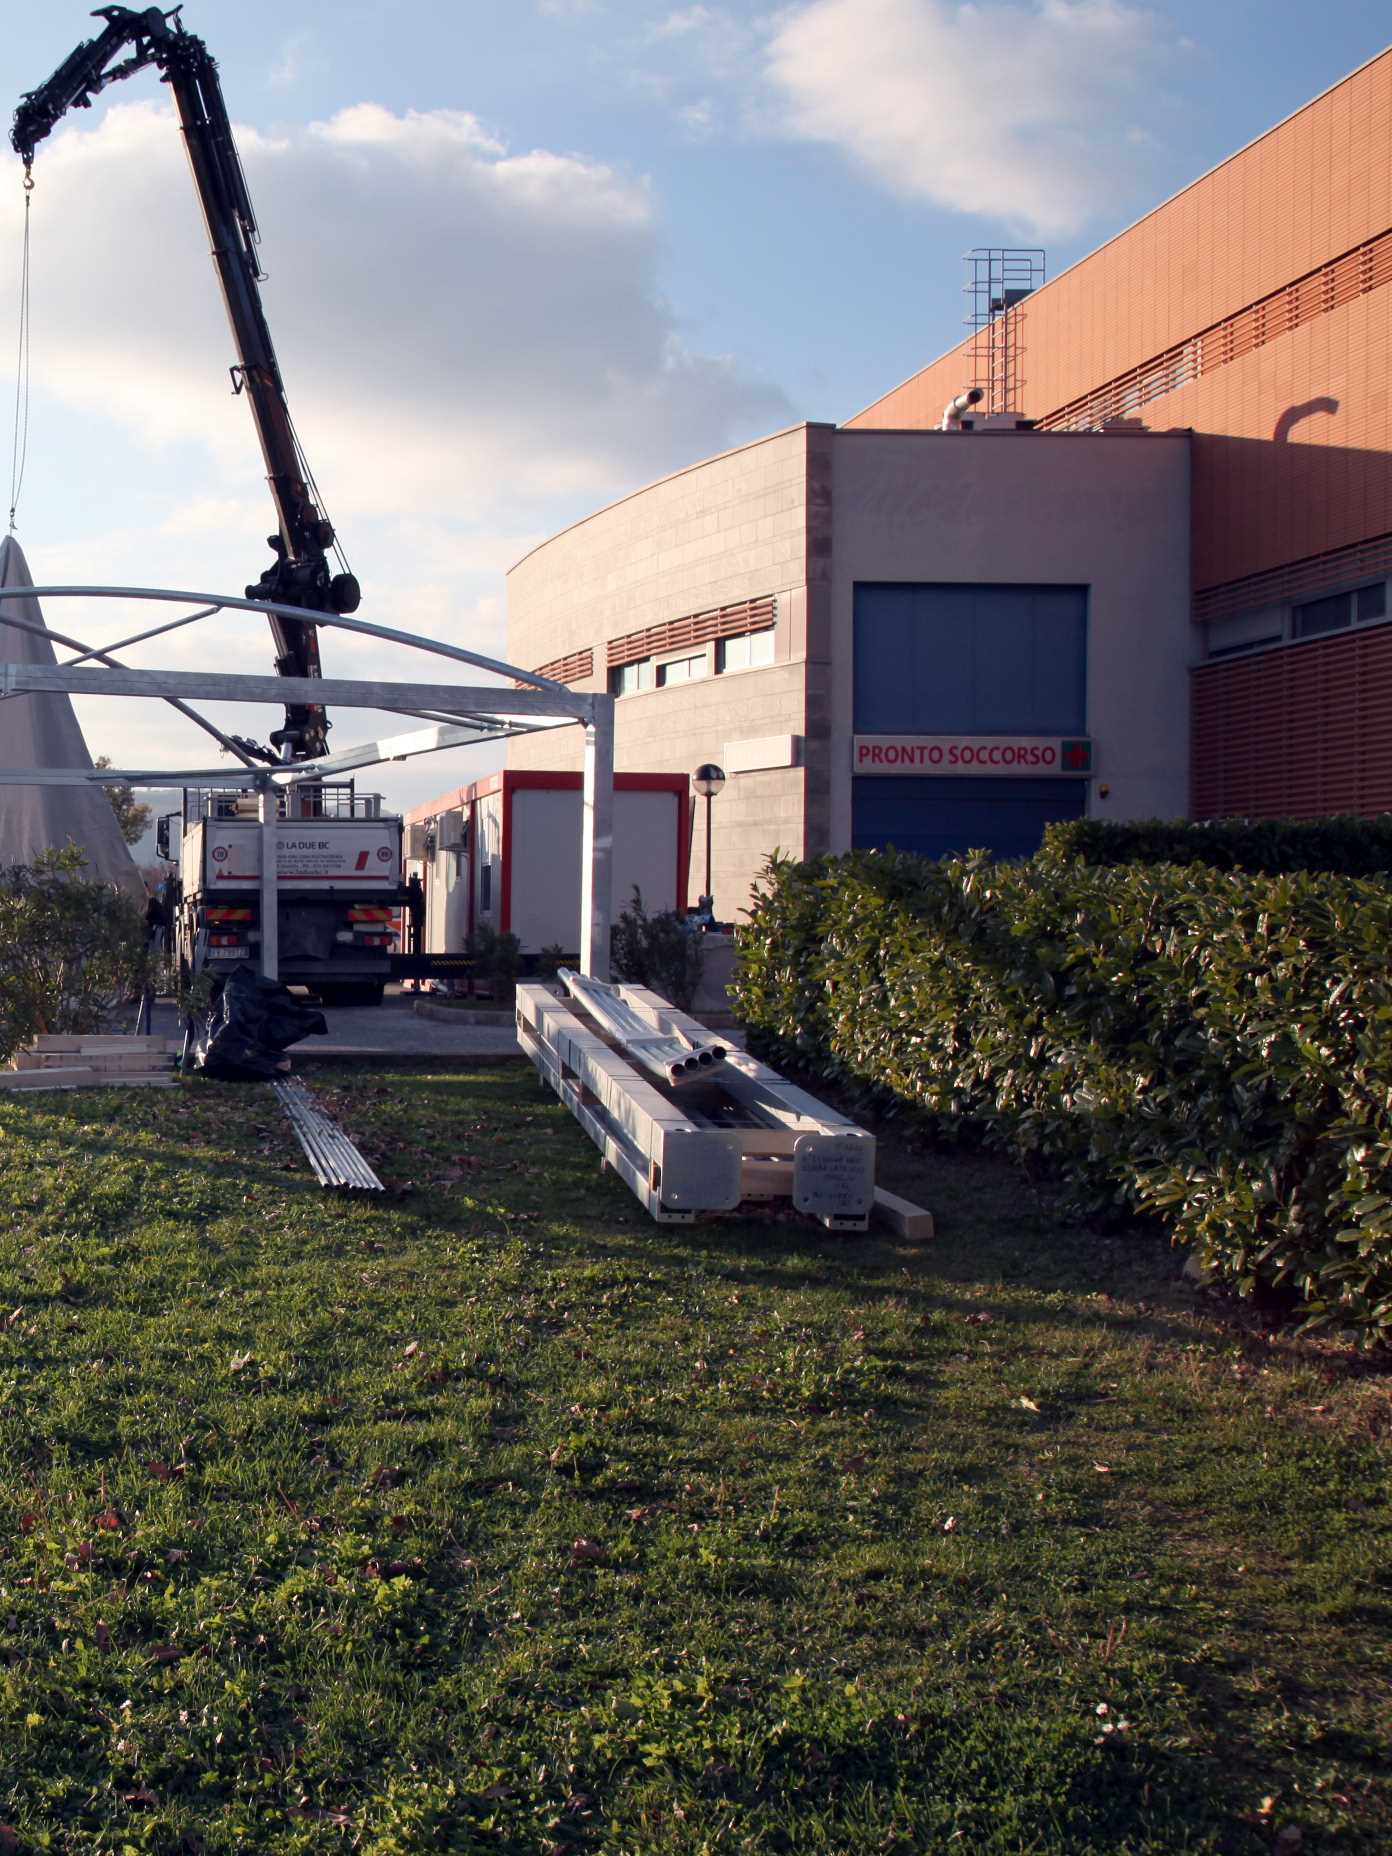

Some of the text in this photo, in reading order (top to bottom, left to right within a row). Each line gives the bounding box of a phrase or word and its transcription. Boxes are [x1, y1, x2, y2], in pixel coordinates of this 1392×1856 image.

[858, 745, 1056, 765] PRONTO SOCCORSO
[286, 841, 297, 850] LA
[298, 841, 317, 850] DUE
